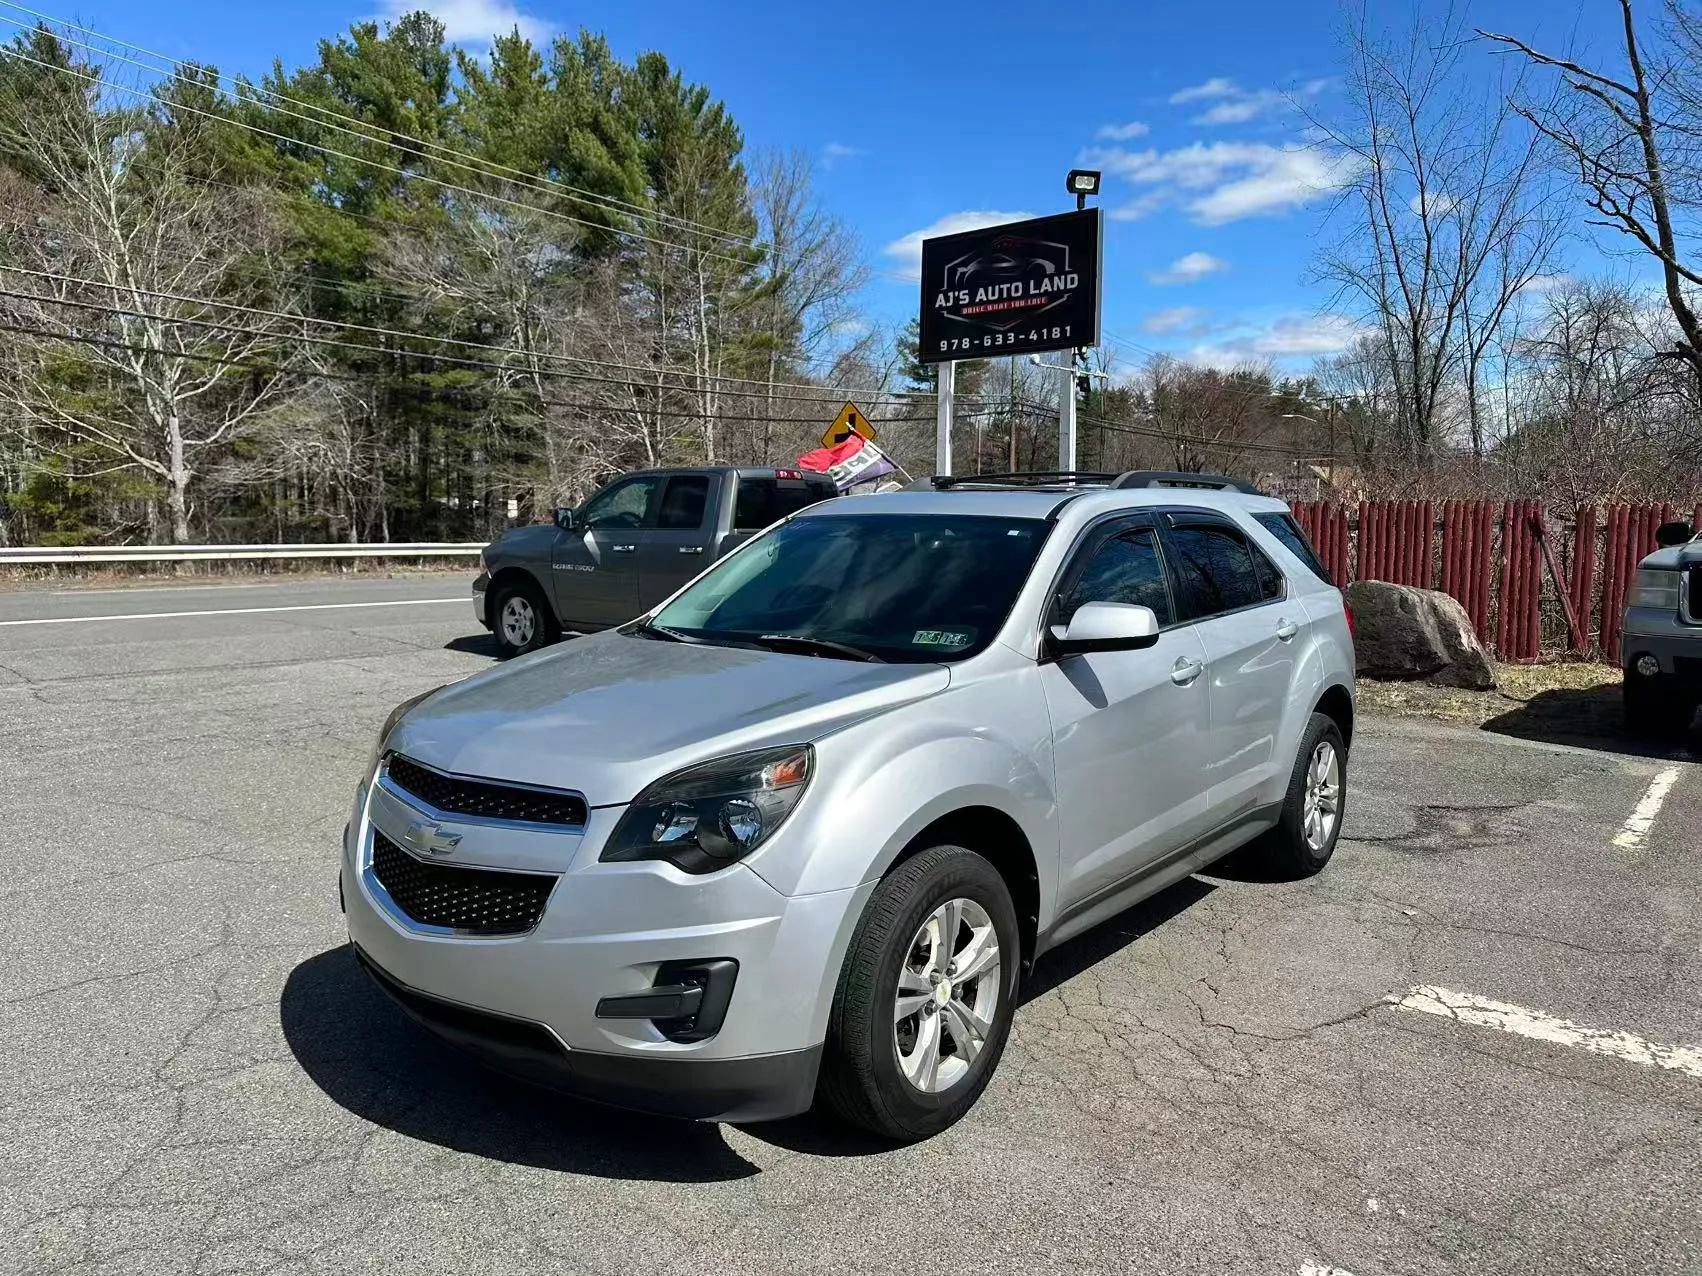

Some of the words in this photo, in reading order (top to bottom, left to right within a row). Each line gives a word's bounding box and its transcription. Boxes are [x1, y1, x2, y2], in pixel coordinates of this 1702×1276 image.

[935, 290, 970, 308] AJ'S
[976, 281, 1023, 302] AUTO
[1029, 273, 1079, 294] LAND
[962, 305, 986, 314] DRIVE
[987, 302, 1007, 312] WHAT
[1011, 300, 1025, 309] YOU
[1028, 297, 1047, 306] LOVE
[940, 326, 1071, 351] 978-633-4181
